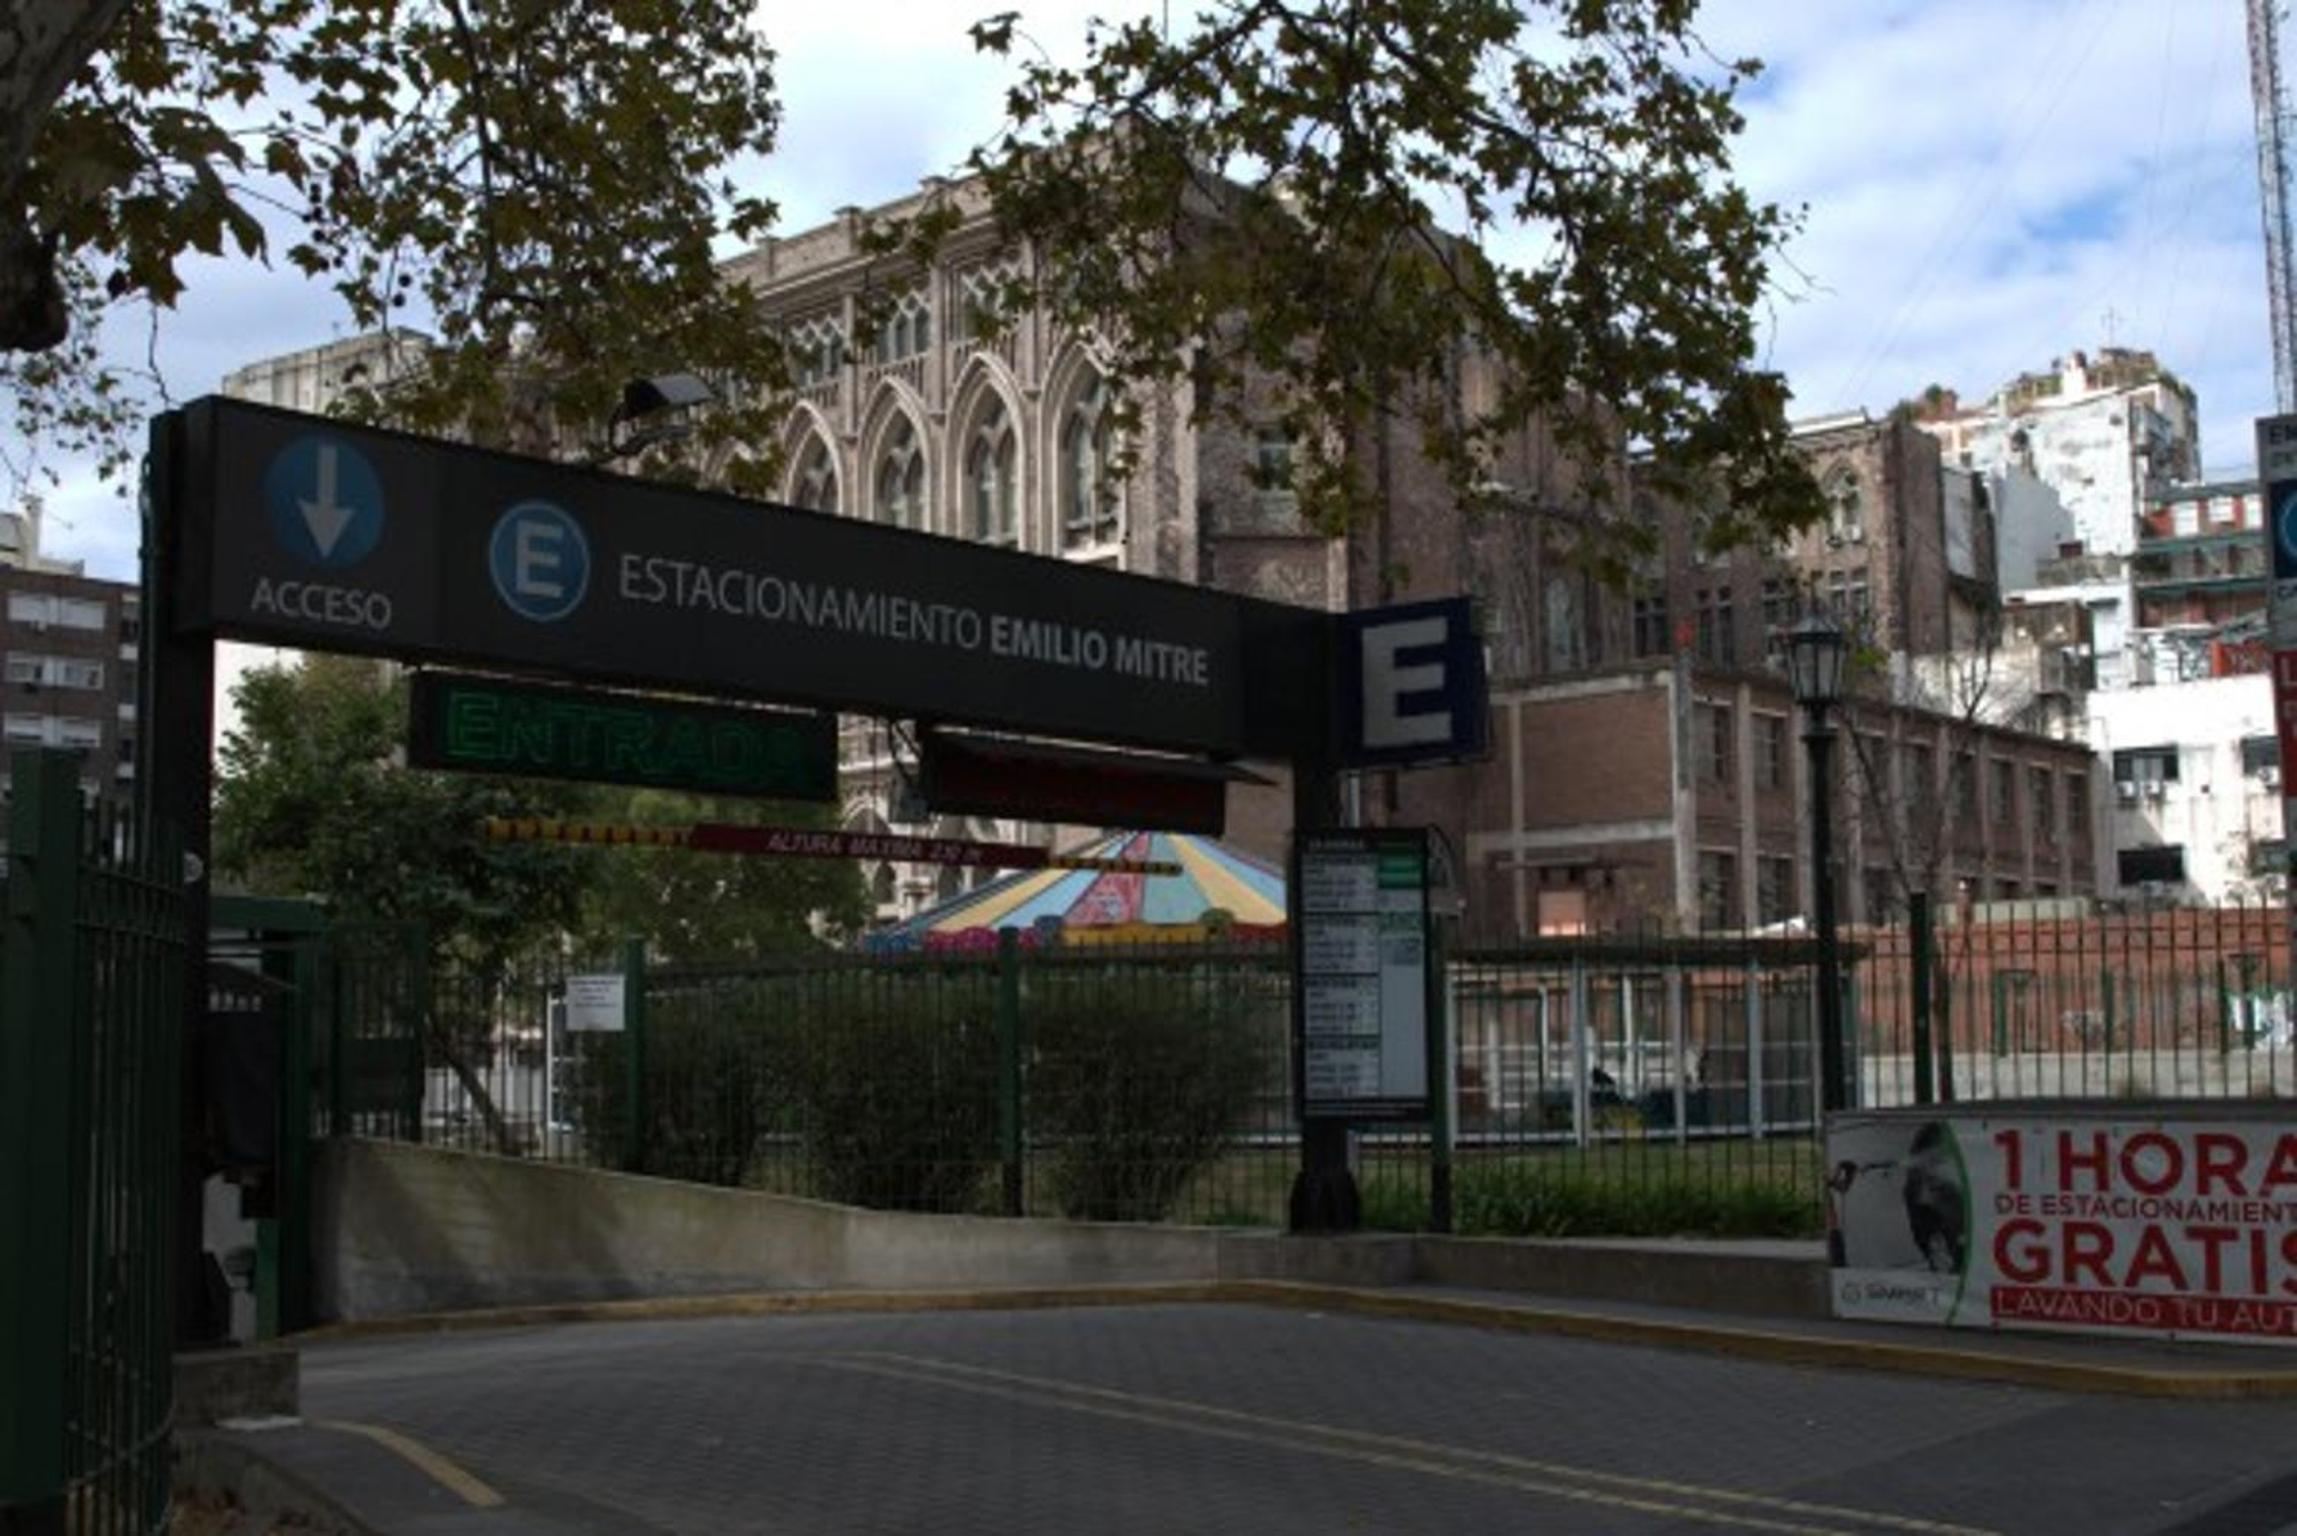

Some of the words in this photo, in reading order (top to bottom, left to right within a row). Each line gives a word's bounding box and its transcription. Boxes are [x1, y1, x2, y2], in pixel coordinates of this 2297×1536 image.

[515, 520, 565, 599] E
[250, 576, 392, 629] ACCESO
[619, 553, 982, 650] ESTACIONAMIENTO
[989, 614, 1108, 670] EMILIO
[1114, 636, 1210, 686] MITRE
[1361, 616, 1453, 749] E
[1994, 1129, 2021, 1190] 1
[1995, 1194, 2031, 1215] DE
[1997, 1288, 2161, 1323] LAVANDO
[2176, 1299, 2219, 1327] TU
